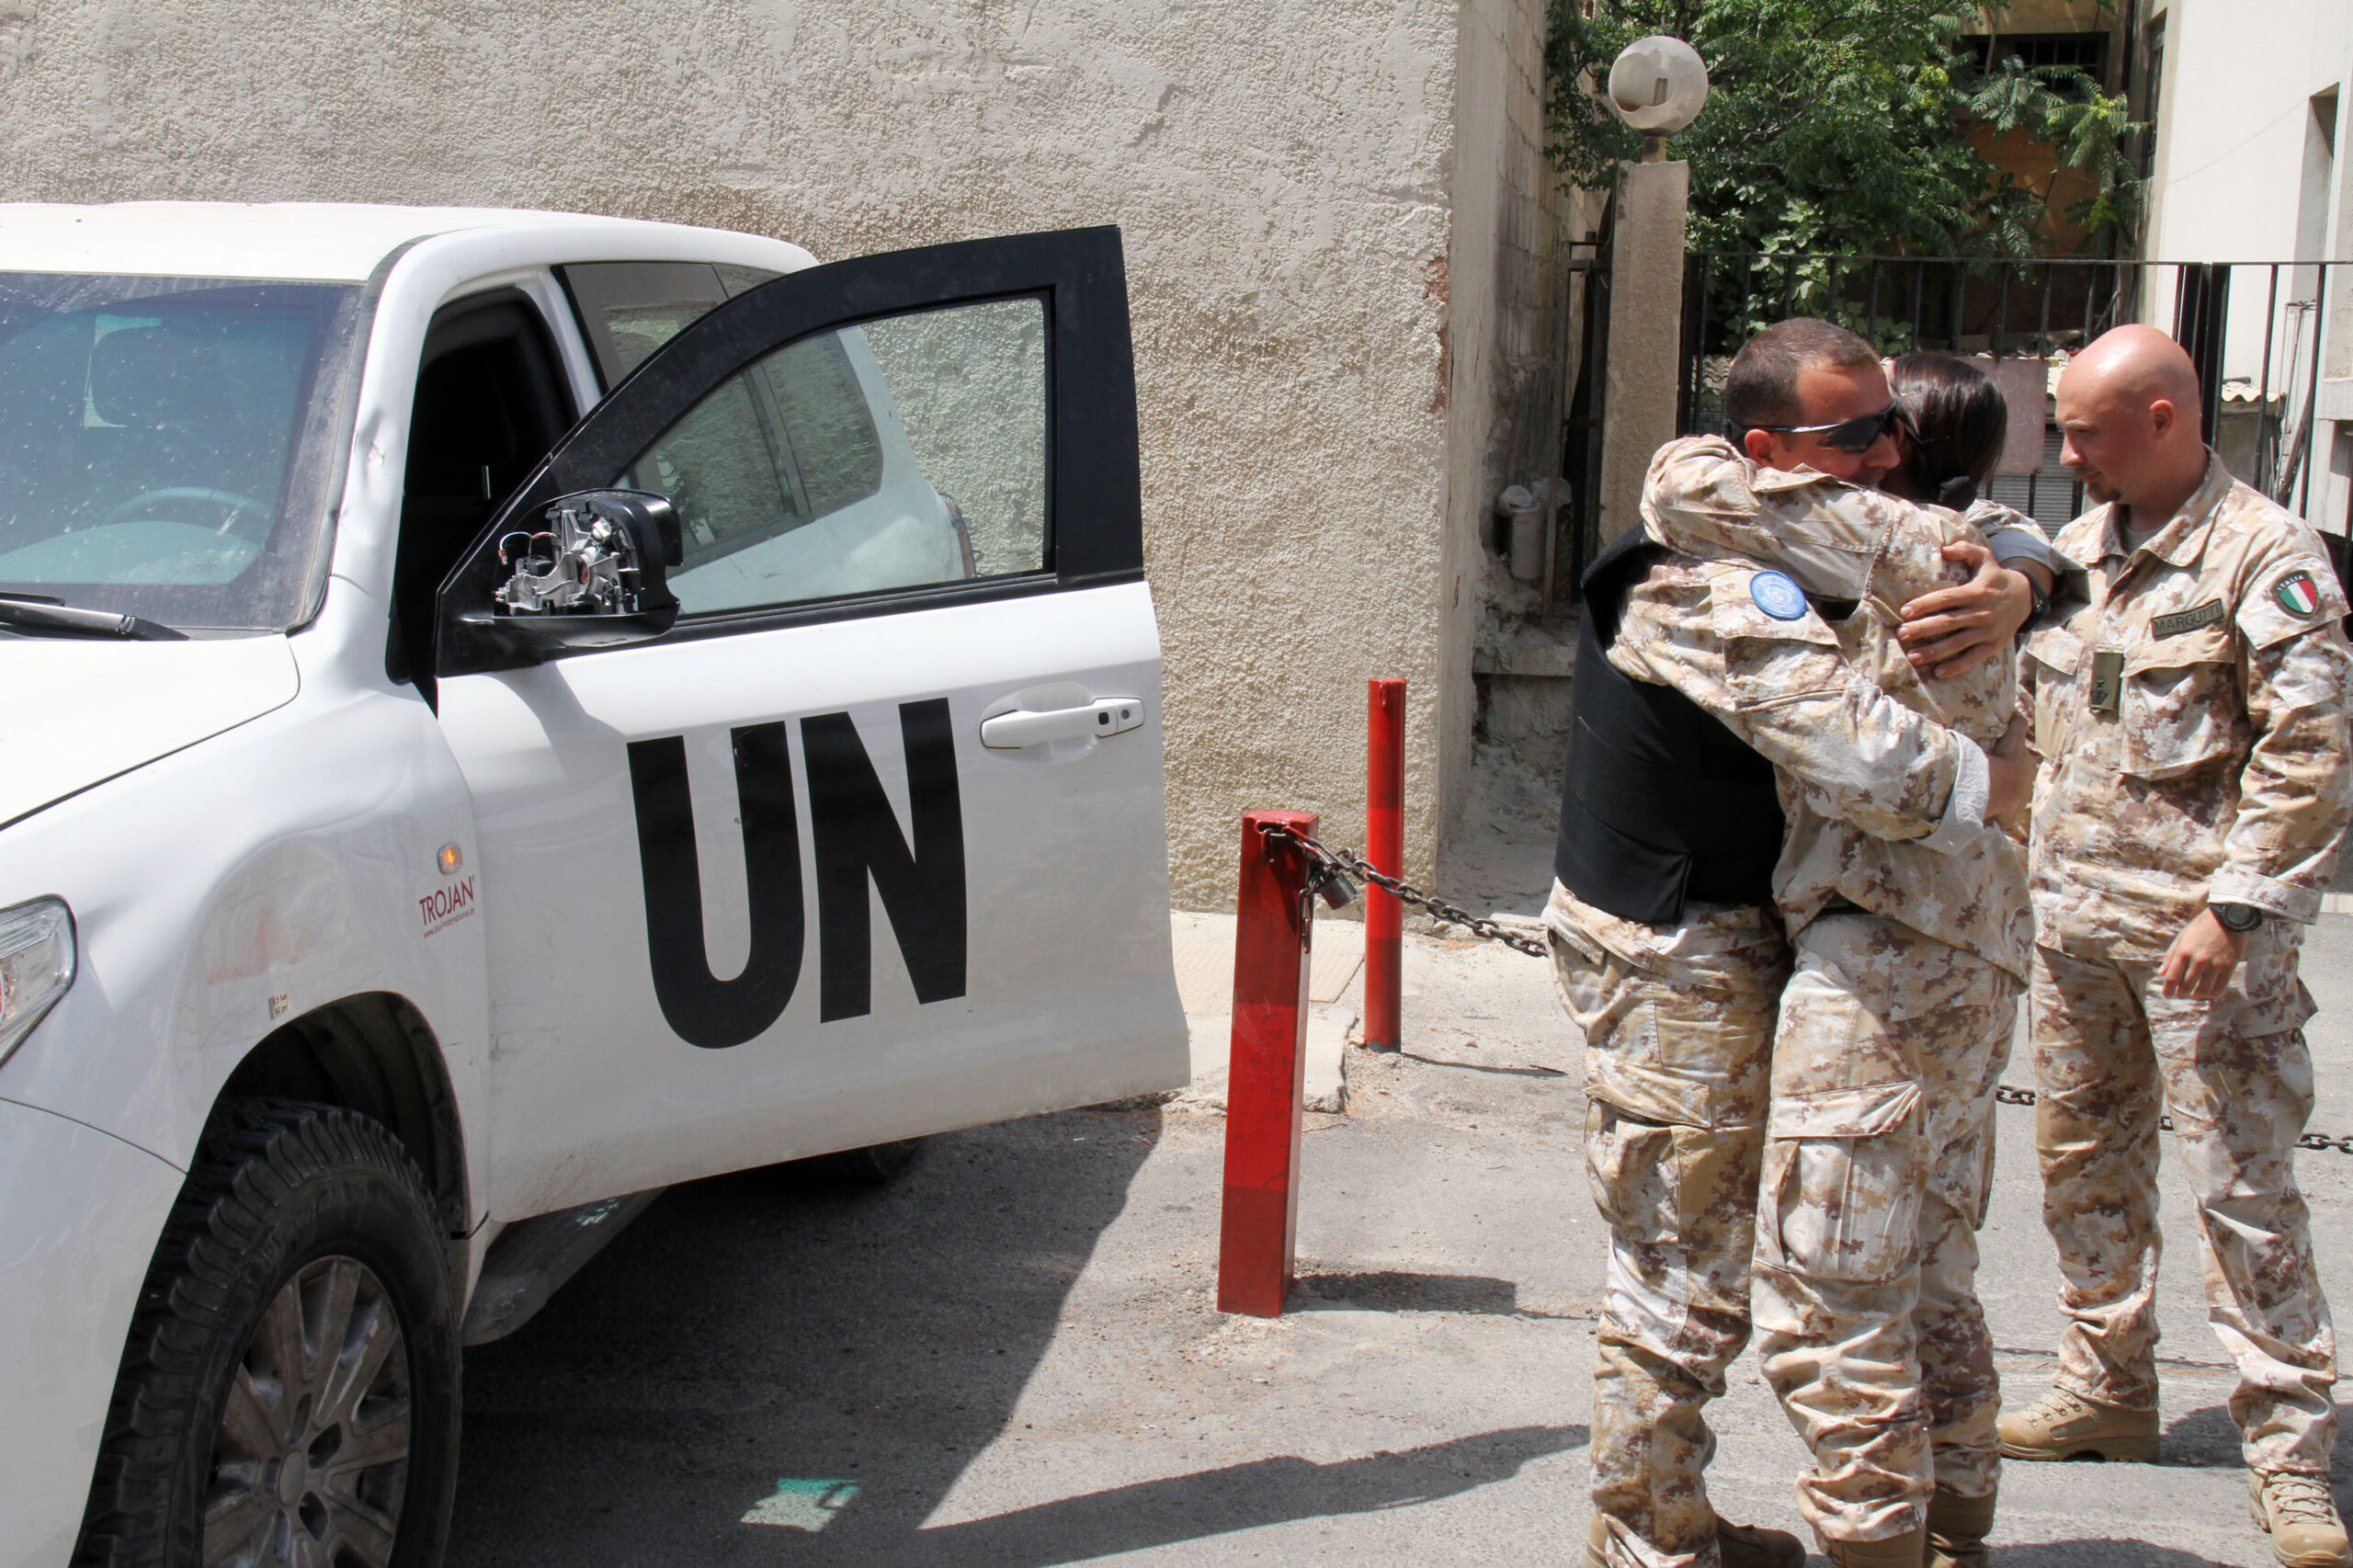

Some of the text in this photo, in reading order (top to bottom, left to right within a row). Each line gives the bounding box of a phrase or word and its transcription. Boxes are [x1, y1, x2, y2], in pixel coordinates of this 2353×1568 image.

[2276, 574, 2304, 591] ITALIA
[2154, 603, 2220, 632] MARGUTTI
[627, 697, 967, 1050] UN
[419, 875, 474, 926] TROJAN
